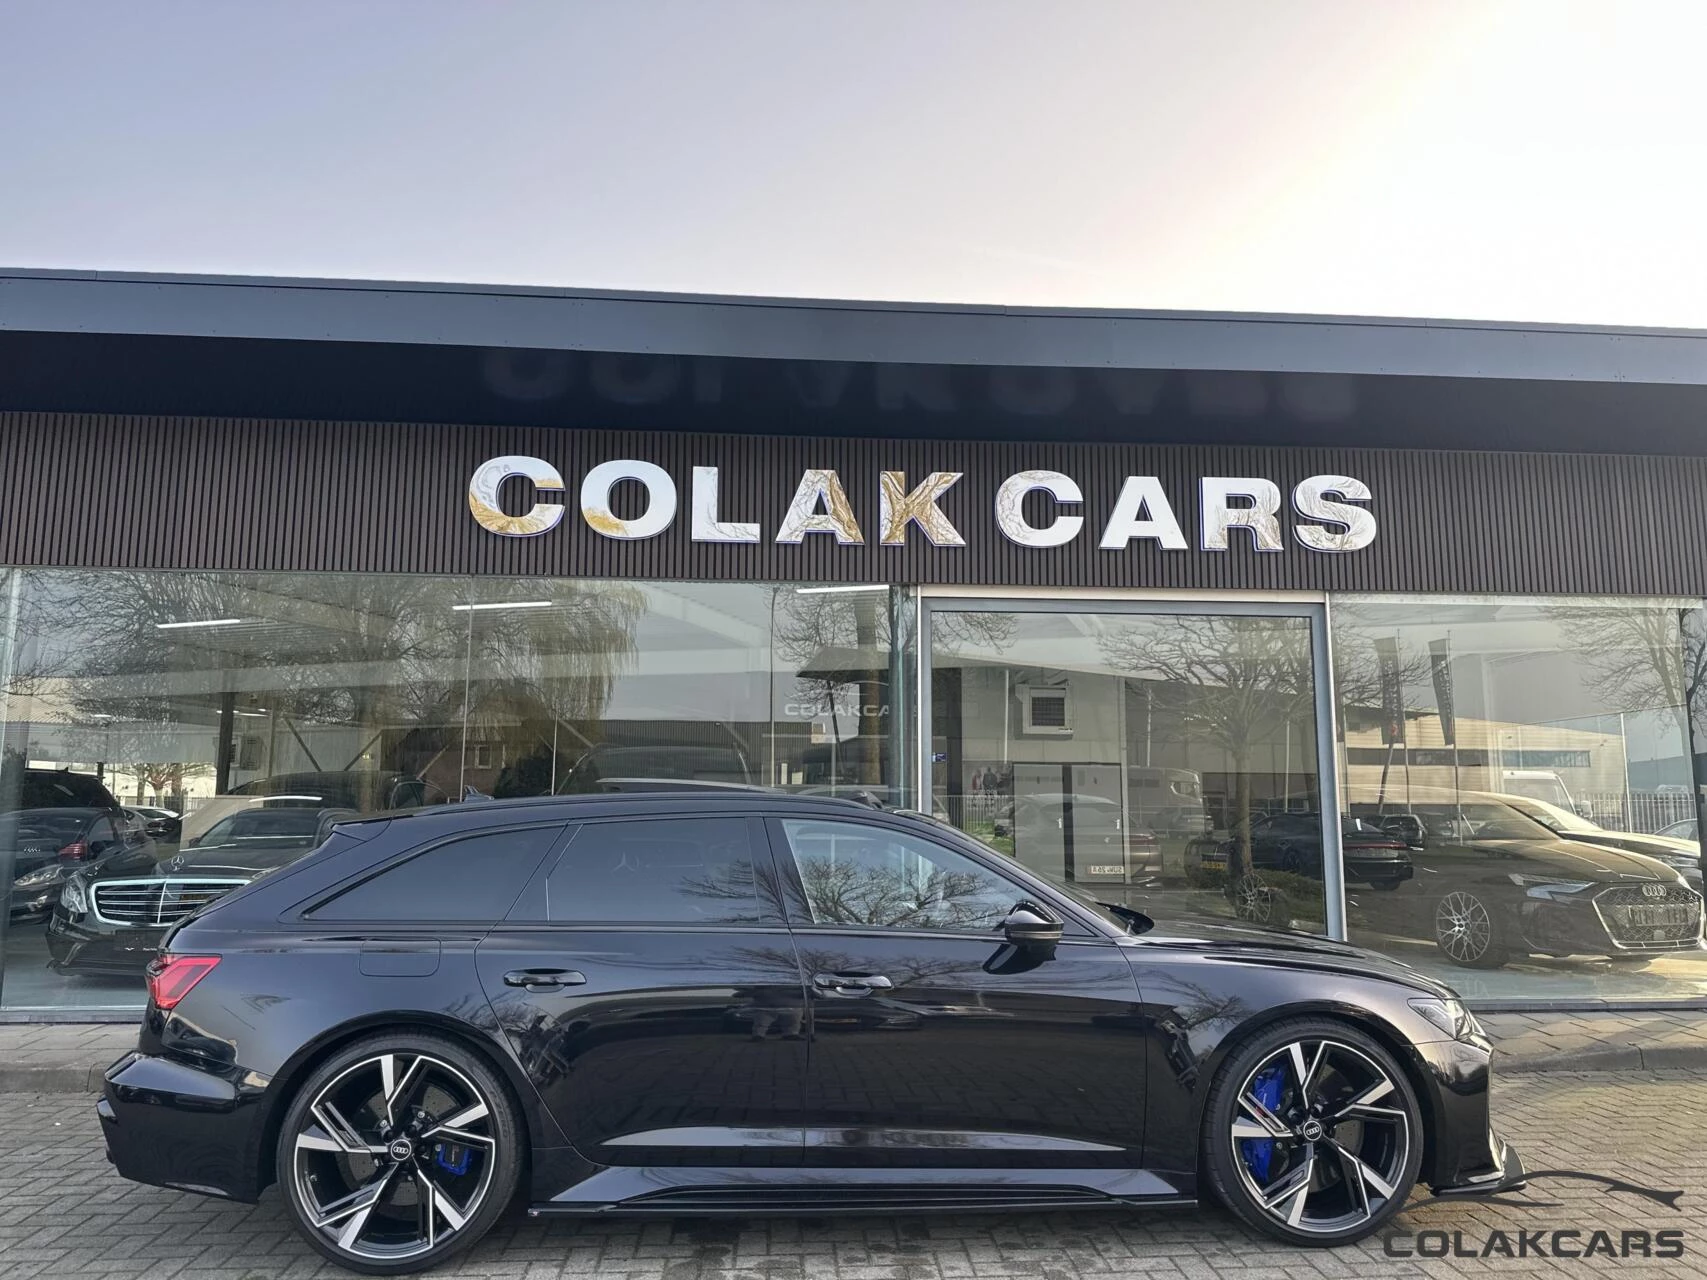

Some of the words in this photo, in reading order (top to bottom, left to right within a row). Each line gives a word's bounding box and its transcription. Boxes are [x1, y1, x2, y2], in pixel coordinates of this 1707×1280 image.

[468, 455, 967, 547] COLAK
[995, 469, 1377, 553] CARS
[784, 703, 889, 717] COLAKCA
